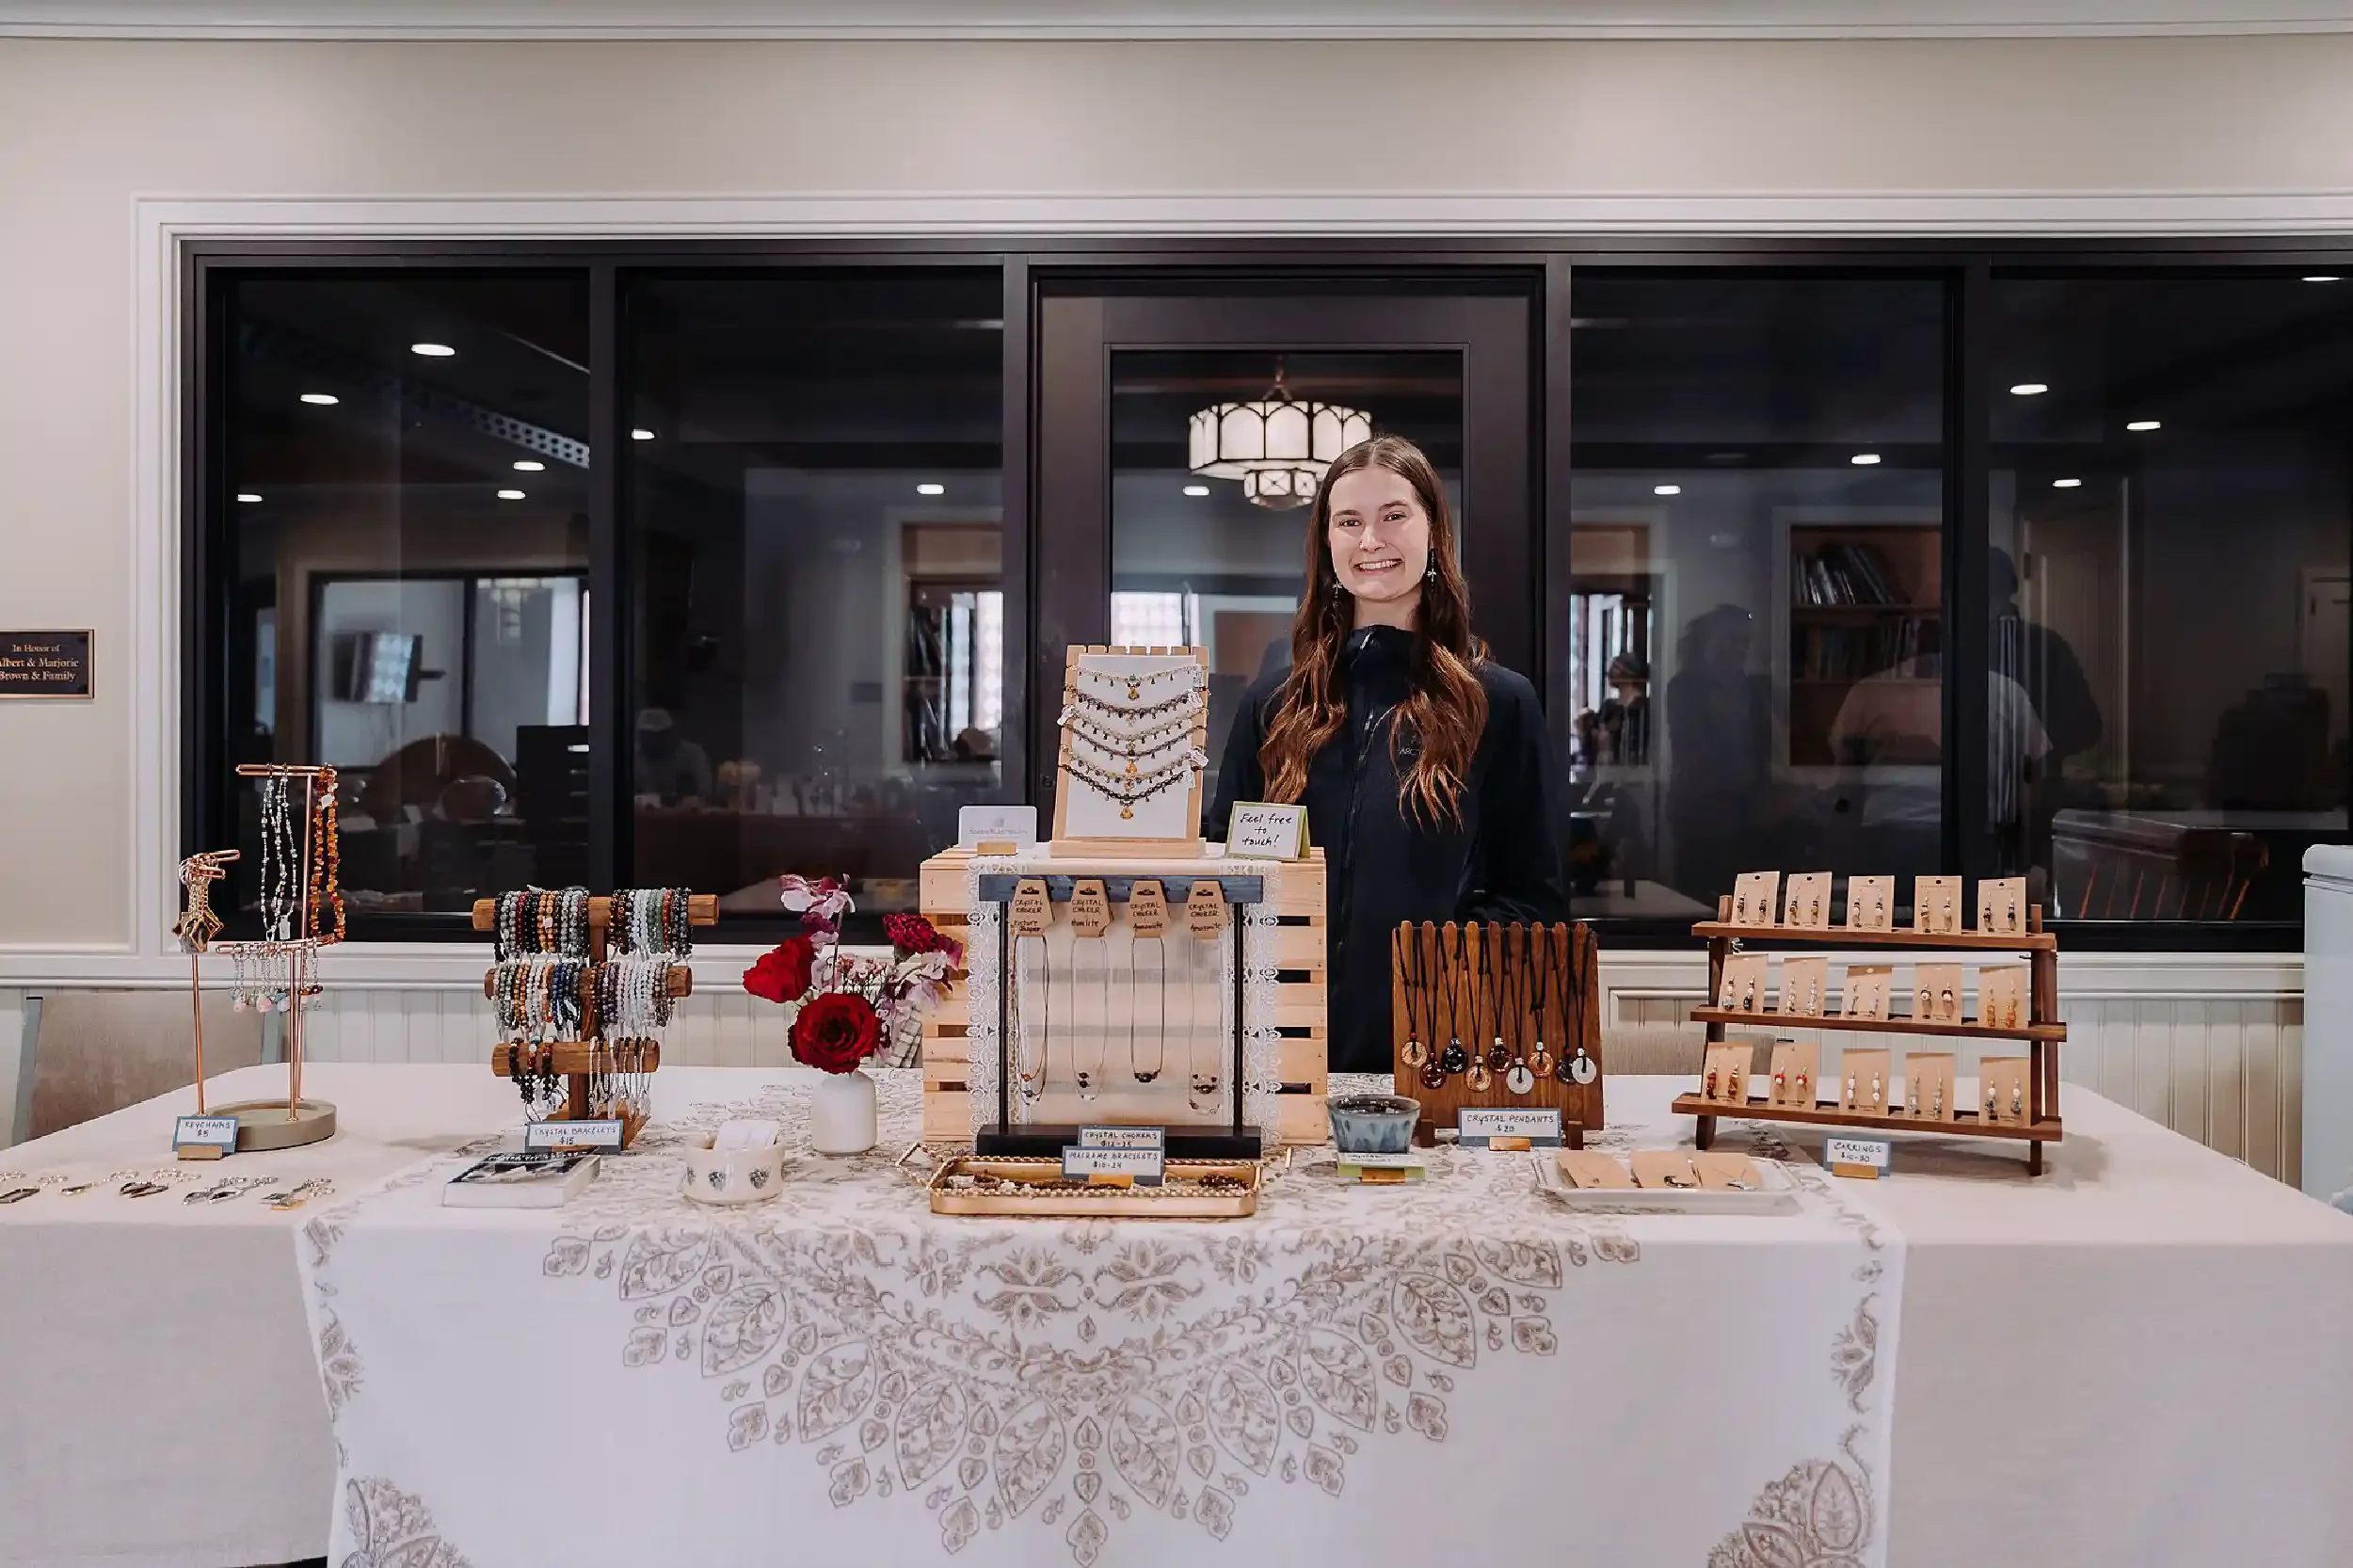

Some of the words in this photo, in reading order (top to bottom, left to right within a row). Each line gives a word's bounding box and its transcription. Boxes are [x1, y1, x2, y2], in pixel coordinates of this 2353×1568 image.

[11, 644, 22, 652] In
[24, 644, 49, 652] Honor
[51, 644, 60, 652] of
[26, 657, 36, 667] &
[38, 657, 79, 669] Marjorie
[31, 670, 40, 680] &
[42, 670, 76, 681] Family
[1240, 812, 1264, 824] Feel
[1268, 812, 1292, 824] free
[1254, 825, 1267, 834] to
[1241, 834, 1280, 848] touch!
[1071, 899, 1104, 908] CRYSTAL
[1130, 903, 1161, 911] CRYSTAL
[1188, 904, 1220, 912] CRYSTAL
[1466, 1113, 1506, 1126] CRYSTAL
[1509, 1113, 1555, 1125] PENDANTS
[184, 1121, 231, 1129] KEYCHAINS
[1495, 1124, 1515, 1133] $20
[196, 1129, 209, 1138] $5
[535, 1128, 568, 1137] CRYSTAL
[571, 1126, 616, 1135] BRACELETS
[1083, 1131, 1119, 1140] CRYSTAL
[1120, 1131, 1159, 1141] CHOKERS
[558, 1135, 575, 1145] $15
[1833, 1142, 1881, 1153] EARRINGS
[1068, 1151, 1108, 1160] MACRAME
[1112, 1151, 1159, 1161] BRACELETS
